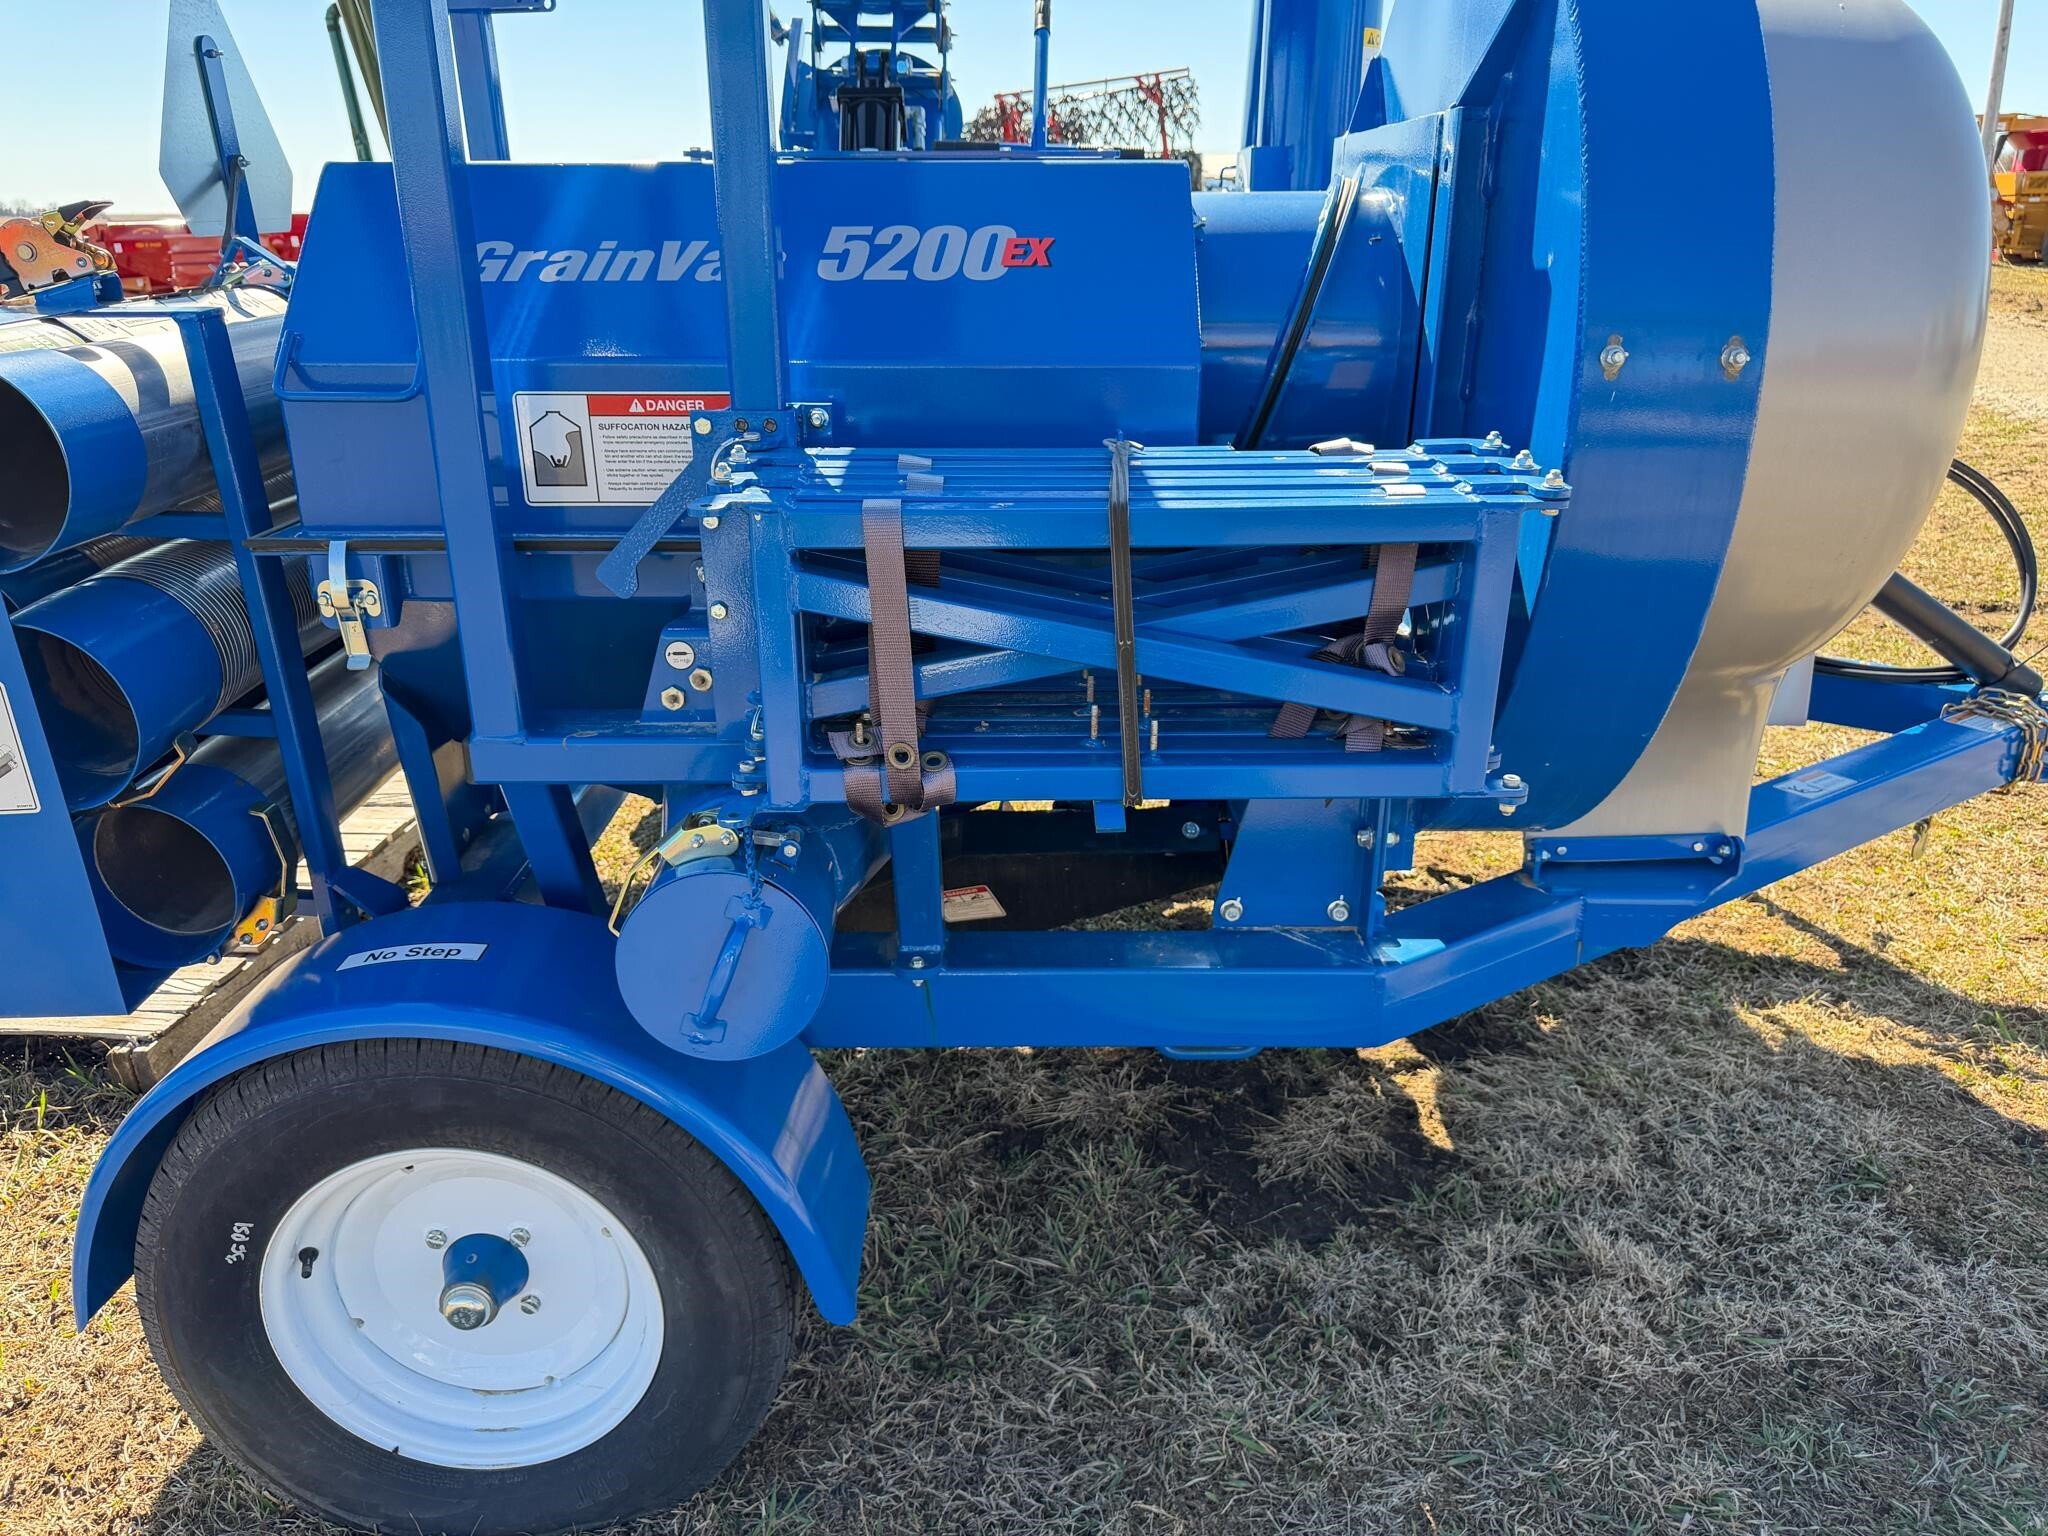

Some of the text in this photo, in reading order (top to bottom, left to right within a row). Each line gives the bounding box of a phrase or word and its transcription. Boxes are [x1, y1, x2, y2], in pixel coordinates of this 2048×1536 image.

[476, 240, 722, 282] GrainVa
[645, 399, 705, 412] DANGER
[598, 423, 660, 431] SUFFOCATION
[364, 947, 462, 963] No Step
